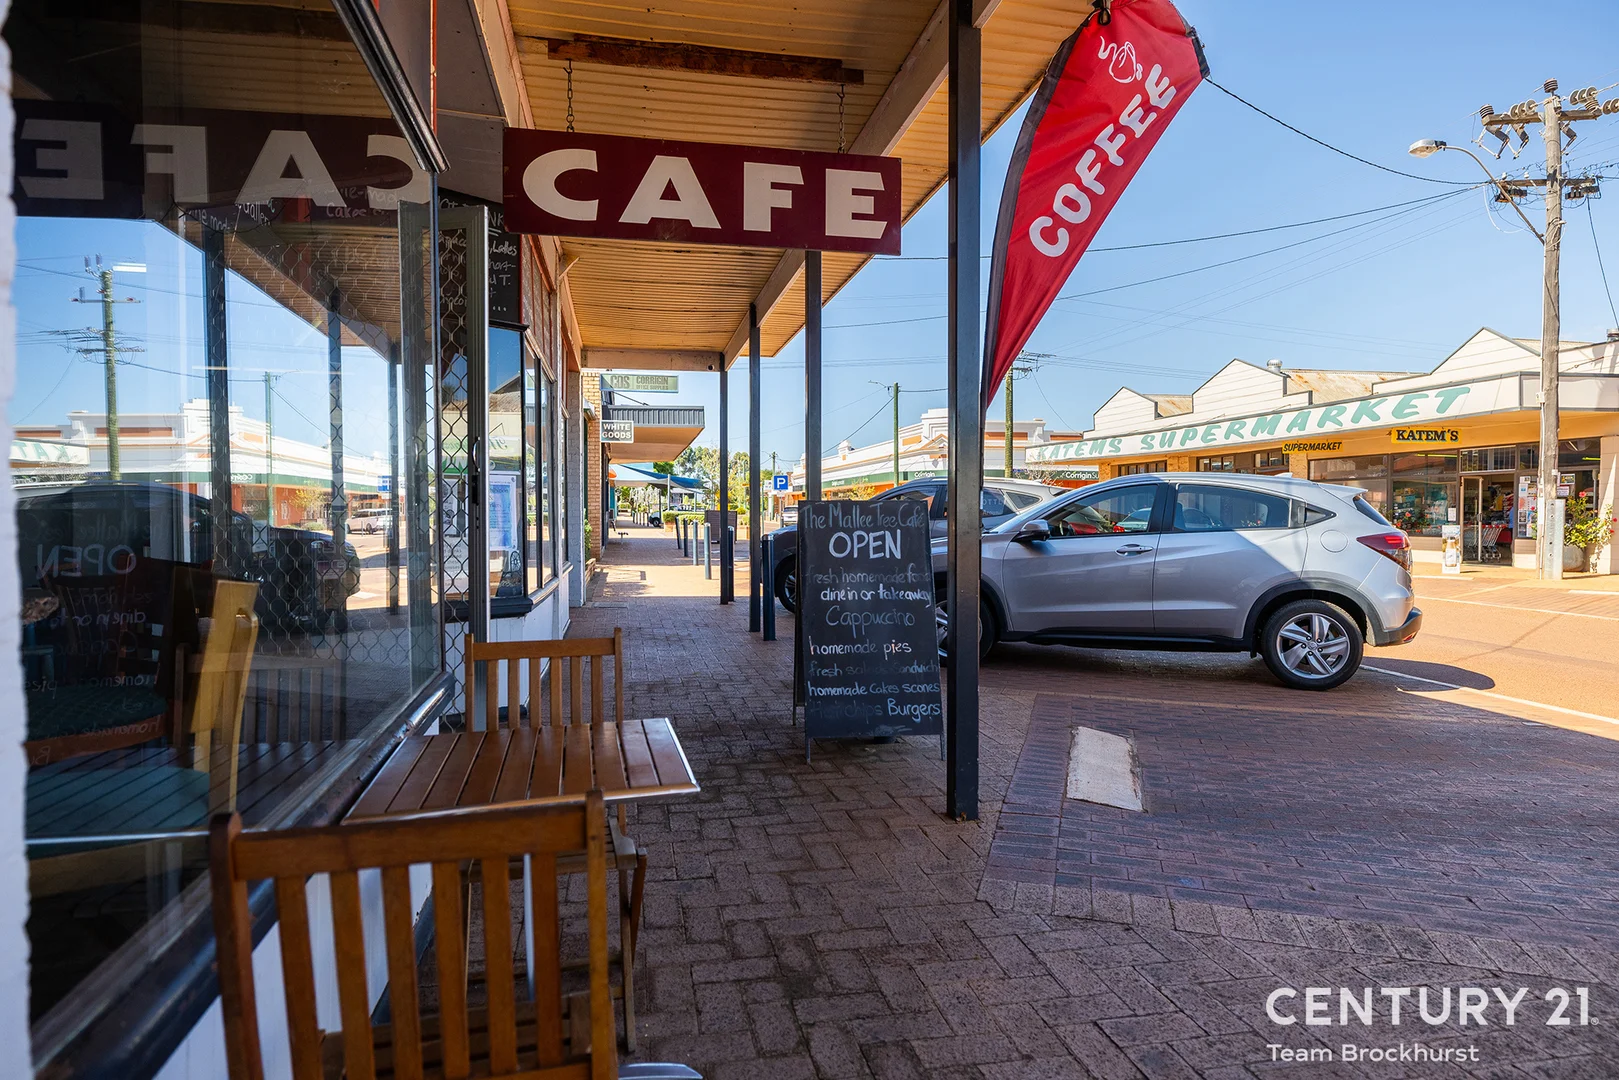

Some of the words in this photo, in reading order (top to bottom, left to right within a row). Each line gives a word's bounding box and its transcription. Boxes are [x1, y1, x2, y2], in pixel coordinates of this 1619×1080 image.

[1029, 63, 1177, 257] COFFEE
[522, 148, 888, 240] CAFE
[636, 375, 669, 385] CORRIGIN
[603, 423, 631, 431] WHITE
[1037, 438, 1123, 461] KATEMS
[1140, 387, 1471, 450] SUPERMARKET
[602, 431, 632, 439] GOODS
[1395, 429, 1459, 442] KATEM'S
[1283, 441, 1342, 453] SUPERMARKET
[776, 477, 786, 489] P
[1065, 470, 1091, 480] Corrigin
[800, 503, 826, 529] The
[829, 502, 874, 529] Mallee
[869, 502, 898, 528] Tree
[829, 529, 902, 559] OPEN
[860, 589, 875, 601] or
[877, 584, 932, 608] takeaway
[826, 605, 915, 638] Cappuccino
[808, 635, 878, 656] homemade
[883, 639, 912, 661] pies
[808, 660, 842, 678] fresh
[807, 680, 868, 697] homemade
[902, 683, 941, 693] scones
[887, 698, 941, 723] Burgers
